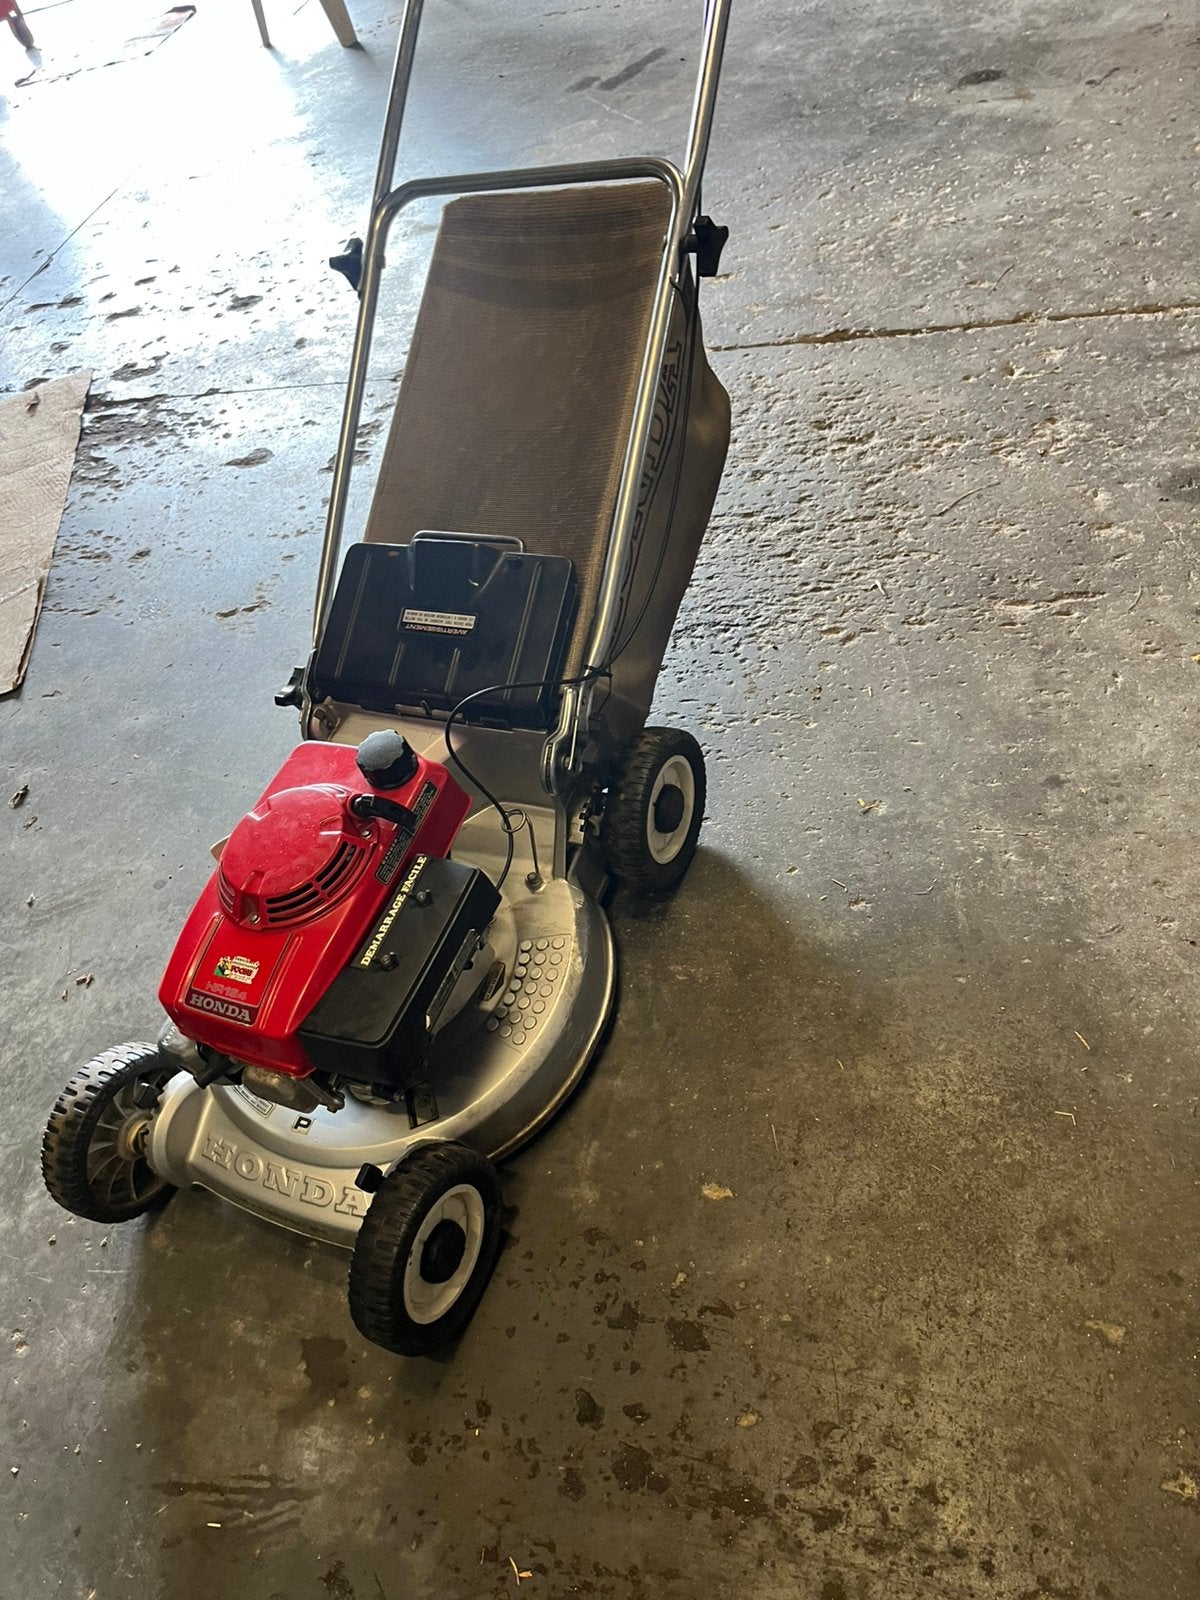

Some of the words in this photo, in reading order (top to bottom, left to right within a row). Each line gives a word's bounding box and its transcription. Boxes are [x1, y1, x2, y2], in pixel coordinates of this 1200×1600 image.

[404, 623, 469, 636] AVERTISSEMENT
[360, 893, 407, 967] DEMARRAGE
[401, 856, 428, 893] FACILE
[189, 993, 252, 1022] HONDA
[293, 1116, 312, 1130] P
[201, 1133, 369, 1218] HONDA
